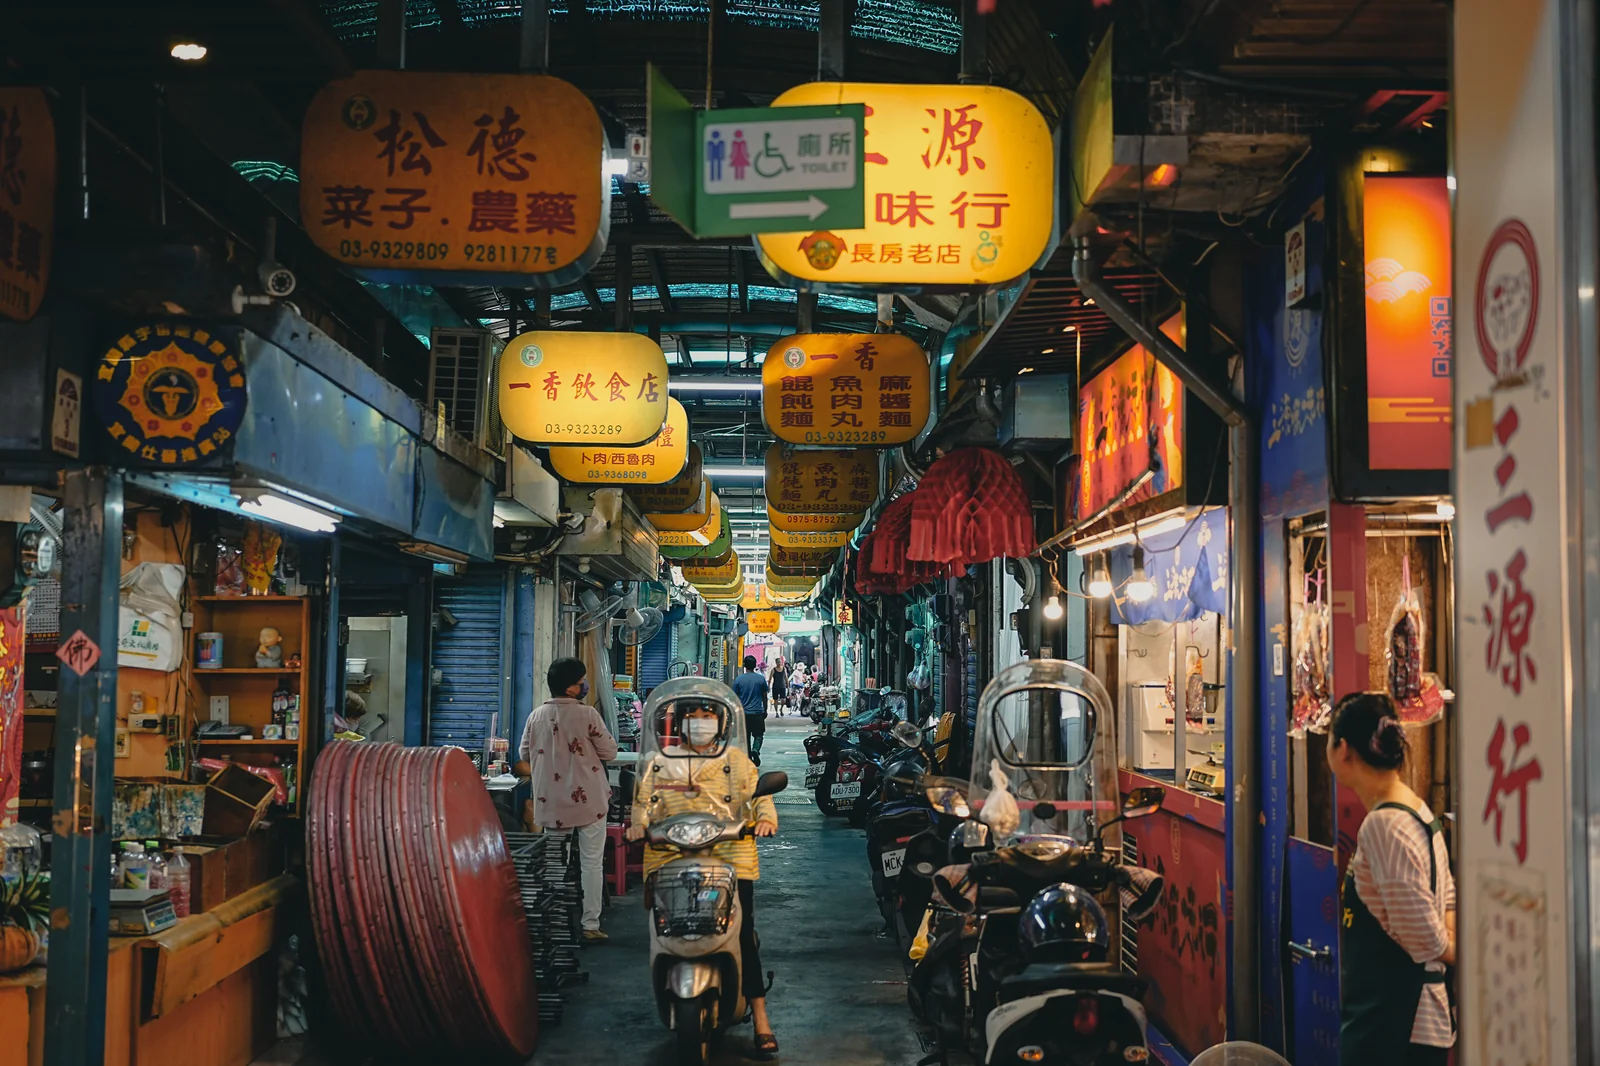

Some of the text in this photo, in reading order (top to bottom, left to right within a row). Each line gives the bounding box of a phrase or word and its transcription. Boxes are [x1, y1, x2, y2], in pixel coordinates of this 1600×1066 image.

[374, 106, 537, 182] 松德
[798, 132, 852, 157] 廁所
[801, 162, 848, 173] TOILET
[340, 240, 449, 260] 03-9329809
[851, 243, 961, 265] 長房老店
[810, 341, 879, 371] 一香
[509, 371, 659, 402] 一香飲食店
[545, 423, 622, 435] 03-9323289
[805, 431, 887, 442] 03-9323289
[581, 452, 655, 466] 卜肉/西魯肉
[588, 470, 647, 479] 03-9368098
[1483, 404, 1543, 866] 三源行
[831, 786, 860, 796] ADU-7300
